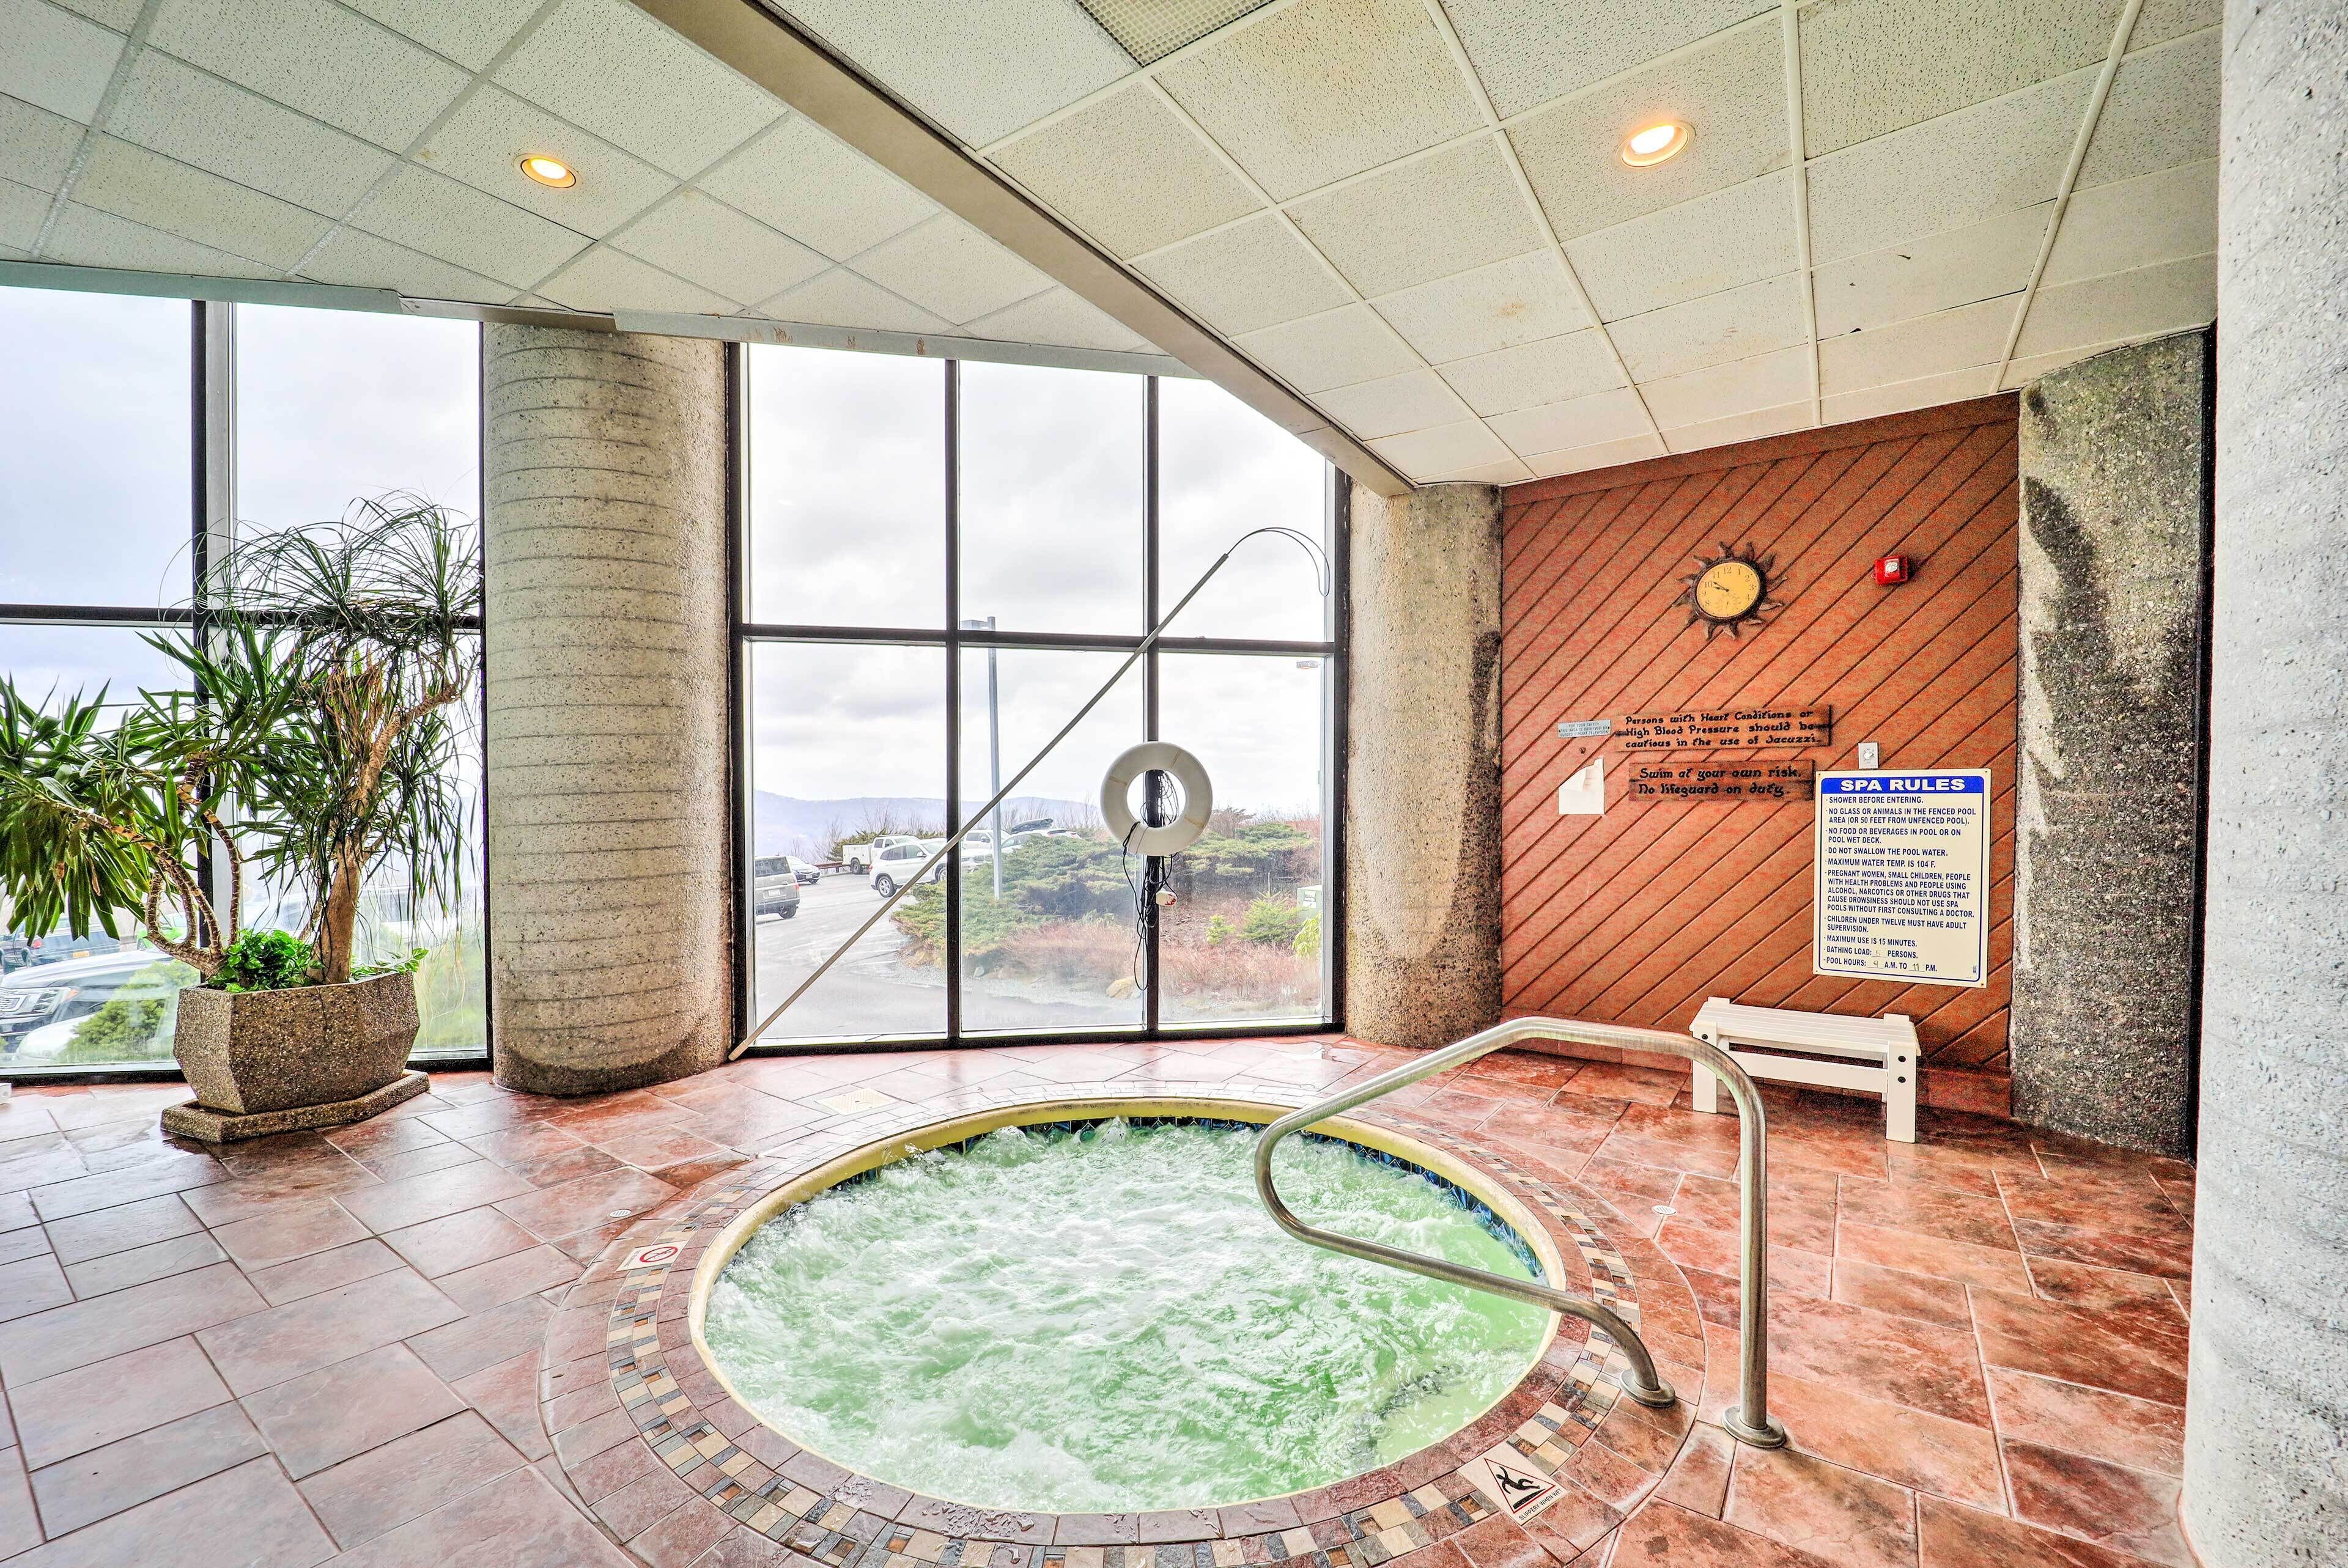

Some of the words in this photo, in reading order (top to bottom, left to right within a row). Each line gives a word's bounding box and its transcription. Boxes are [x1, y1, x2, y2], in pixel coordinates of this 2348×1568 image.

[1671, 715, 1694, 723] with
[1701, 713, 1730, 722] Heart
[1735, 710, 1791, 720] Conditions
[1626, 727, 1649, 738] High
[1654, 727, 1683, 735] Blood
[1689, 725, 1740, 734] Pressure
[1749, 723, 1790, 732] should
[1800, 721, 1813, 731] be
[1748, 736, 1759, 745] of
[1640, 768, 1673, 778] Swim
[1678, 768, 1693, 778] at
[1697, 770, 1724, 781] your
[1768, 765, 1801, 777] risk.
[1639, 784, 1655, 793] No
[1661, 782, 1718, 797] lifeguard
[1726, 785, 1741, 793] on
[1749, 782, 1790, 797] duty.
[1840, 780, 1883, 791] SPA
[1890, 779, 1965, 791] RULES
[1888, 950, 1918, 959] PERSONS.
[1519, 1503, 1540, 1520] SLIPPERY
[1539, 1495, 1553, 1506] WHEN
